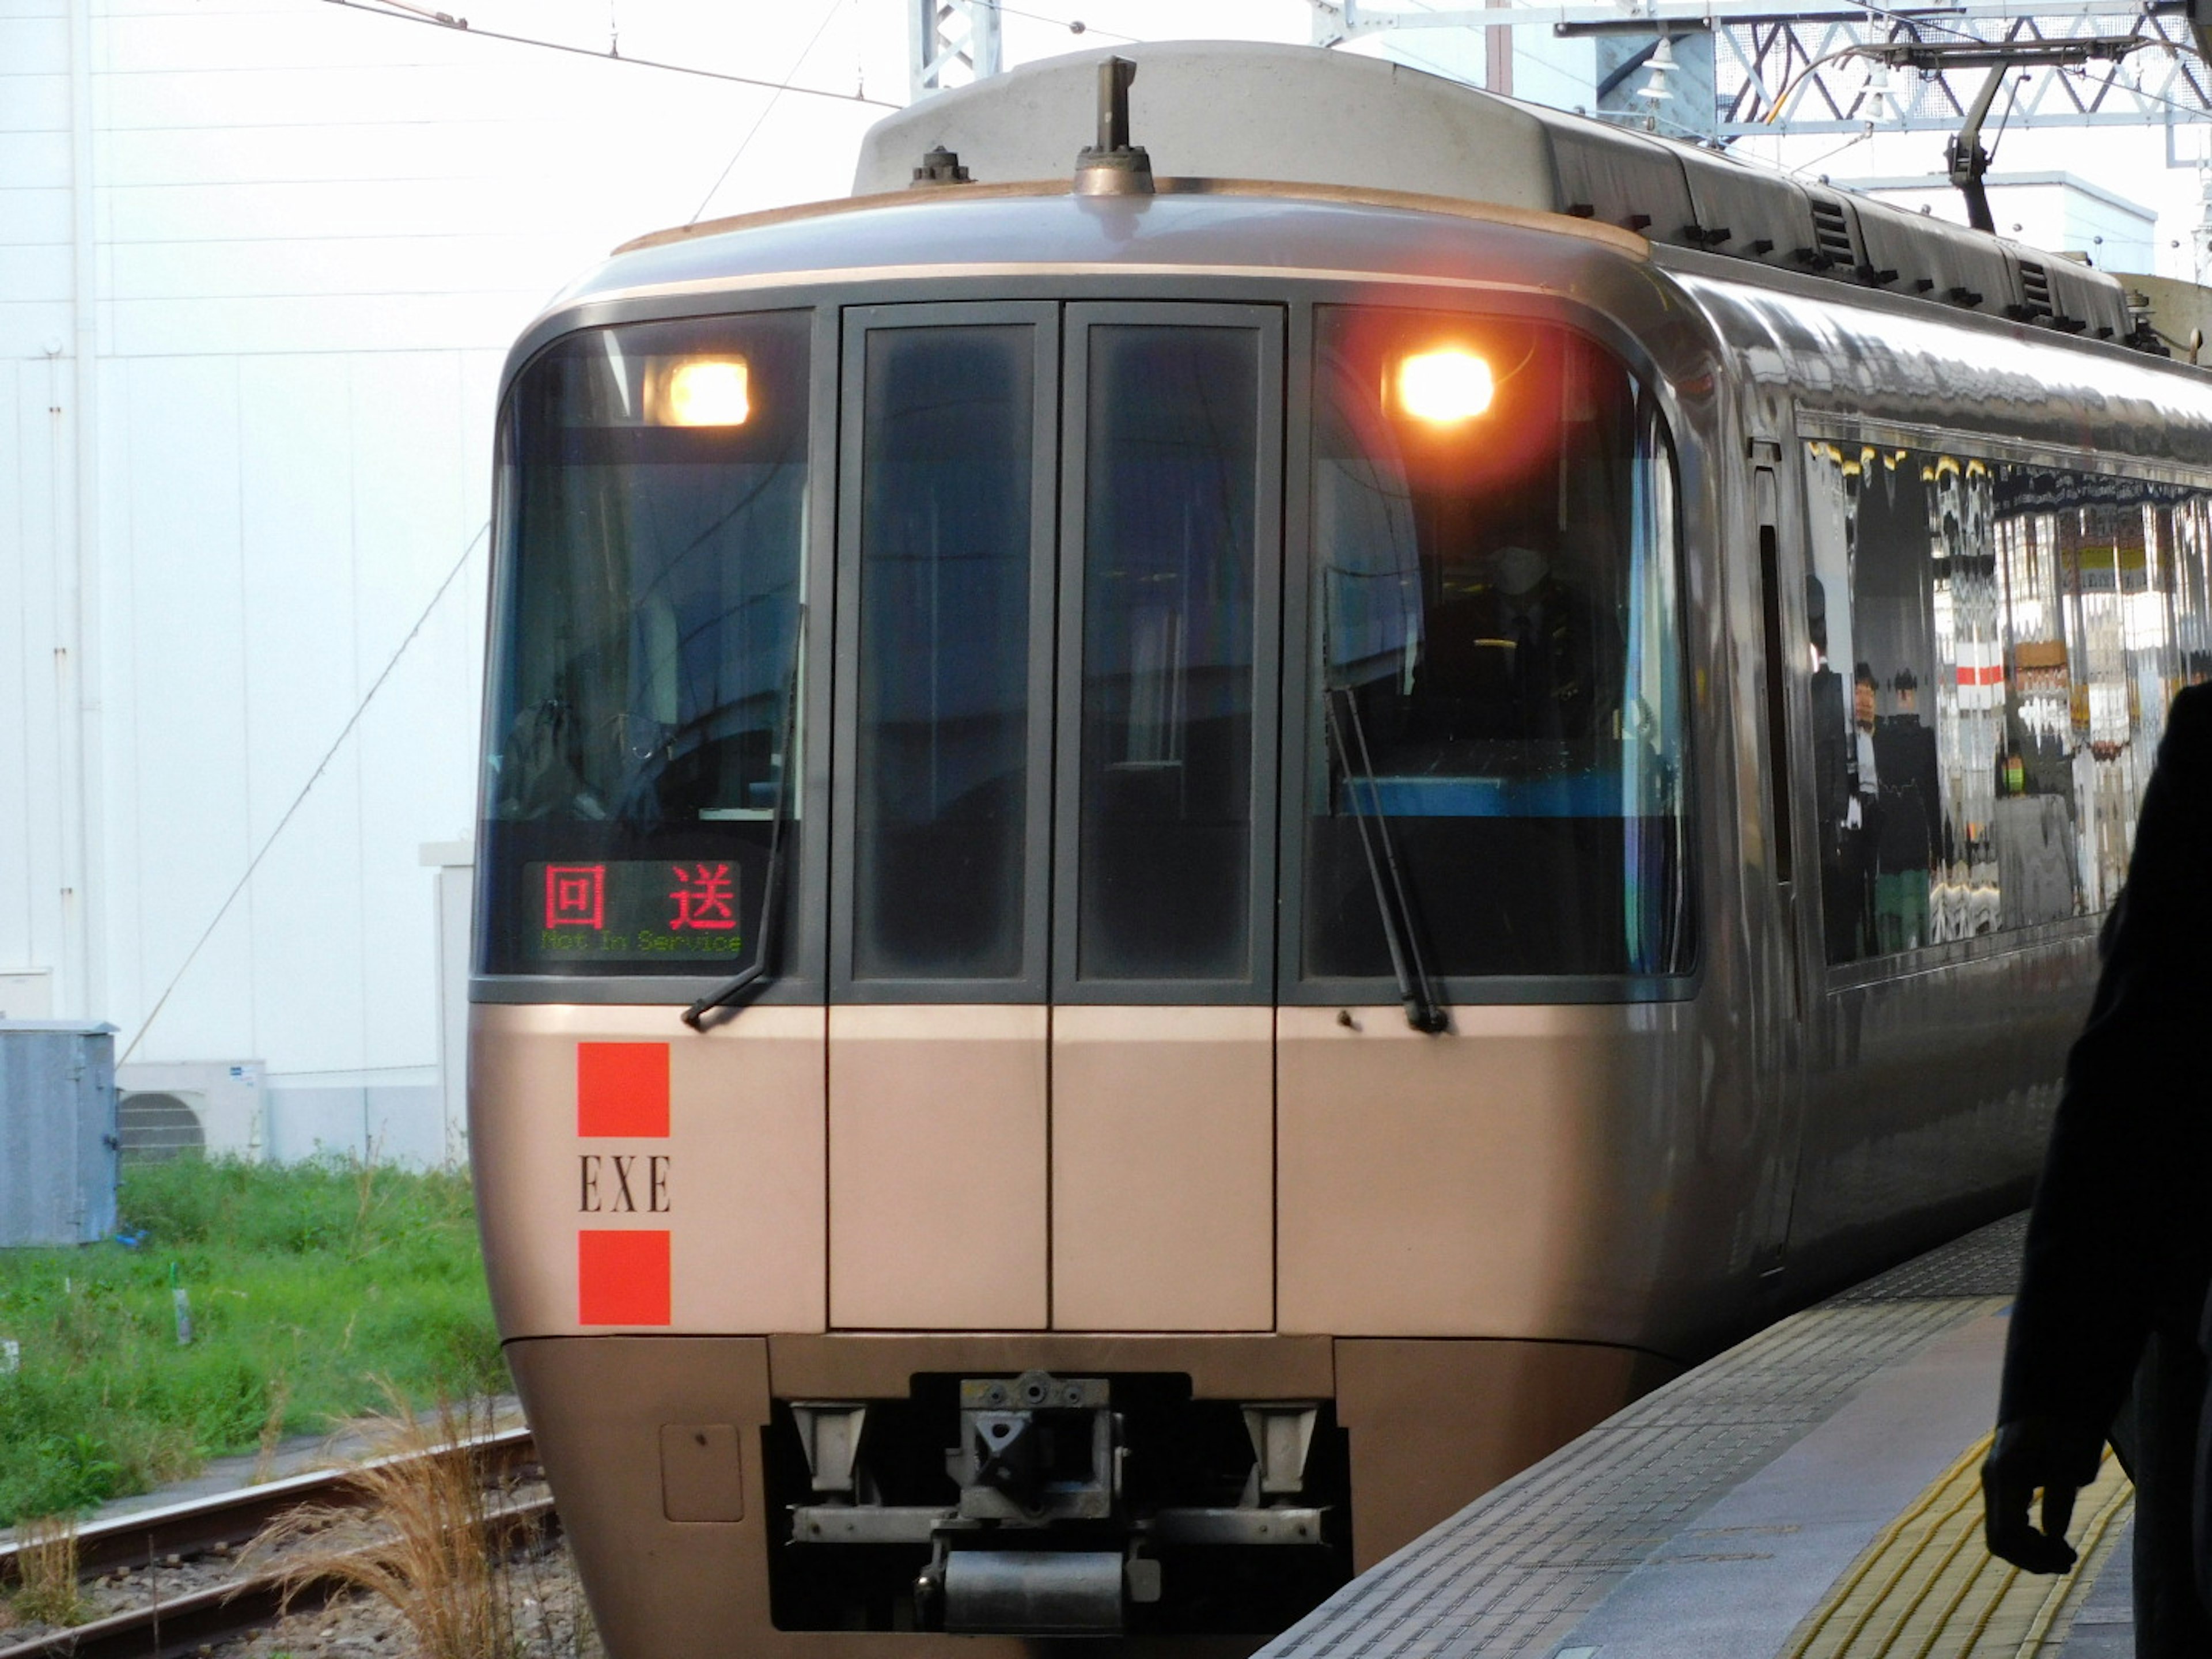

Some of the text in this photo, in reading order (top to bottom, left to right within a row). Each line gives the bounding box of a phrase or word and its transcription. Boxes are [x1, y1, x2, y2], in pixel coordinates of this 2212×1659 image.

[546, 863, 736, 930] 回送
[541, 930, 588, 950] Not
[638, 930, 742, 952] Service
[578, 1154, 670, 1213] EXE
